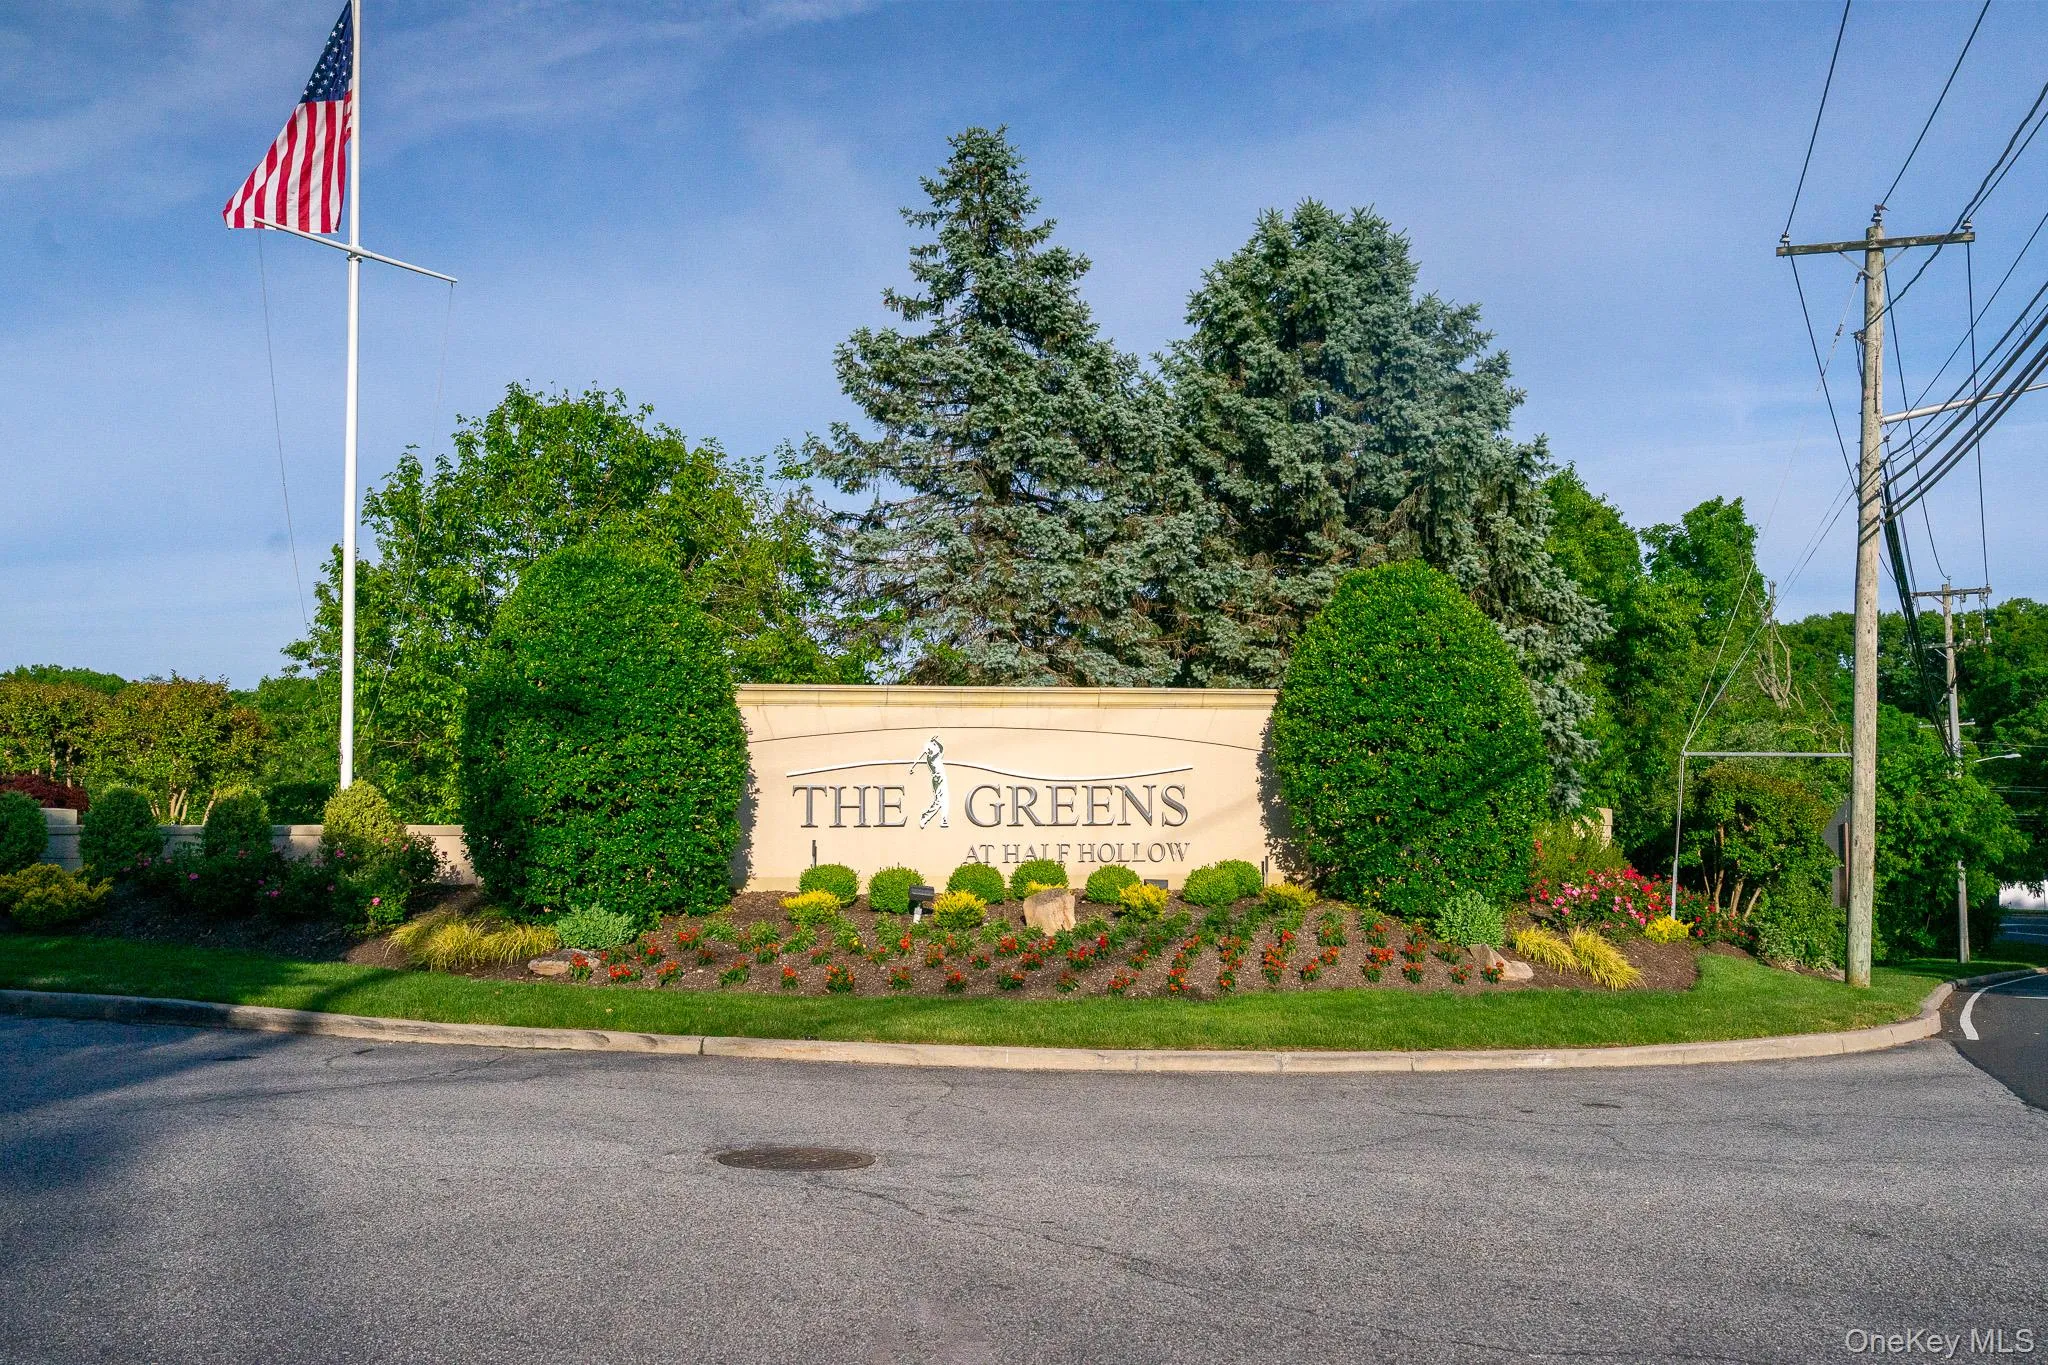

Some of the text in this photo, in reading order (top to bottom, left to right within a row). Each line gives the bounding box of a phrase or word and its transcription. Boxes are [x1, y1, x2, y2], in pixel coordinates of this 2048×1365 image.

[792, 784, 1189, 828] THE GREENS
[963, 844, 995, 864] AT
[1077, 842, 1191, 863] HOLLOW
